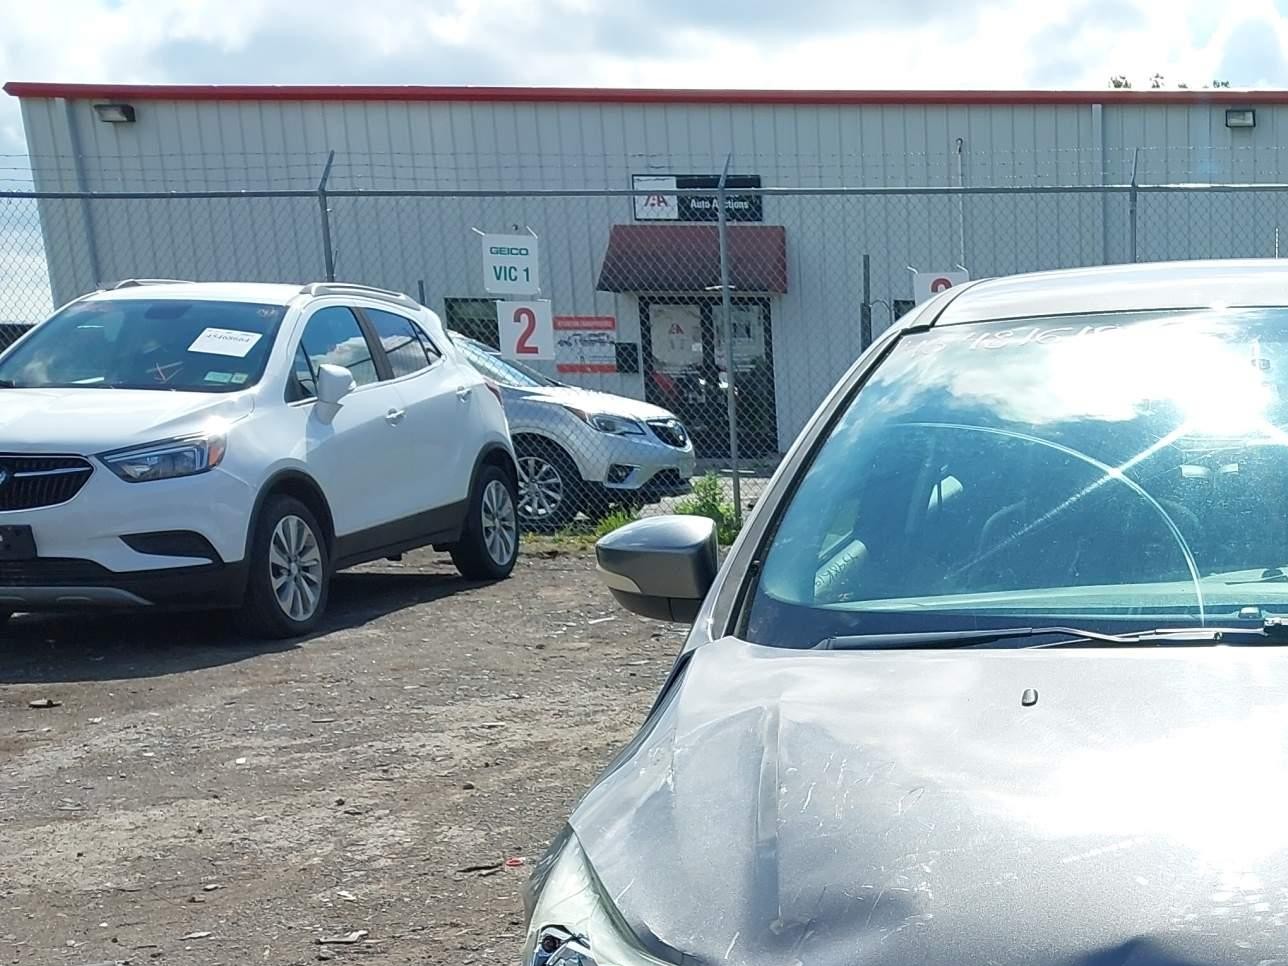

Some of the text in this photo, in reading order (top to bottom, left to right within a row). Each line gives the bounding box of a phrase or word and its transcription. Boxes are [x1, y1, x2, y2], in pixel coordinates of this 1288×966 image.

[690, 198, 749, 209] Auto Actions
[489, 246, 529, 256] GEICO
[493, 265, 530, 282] VIC 1
[513, 307, 539, 354] 2
